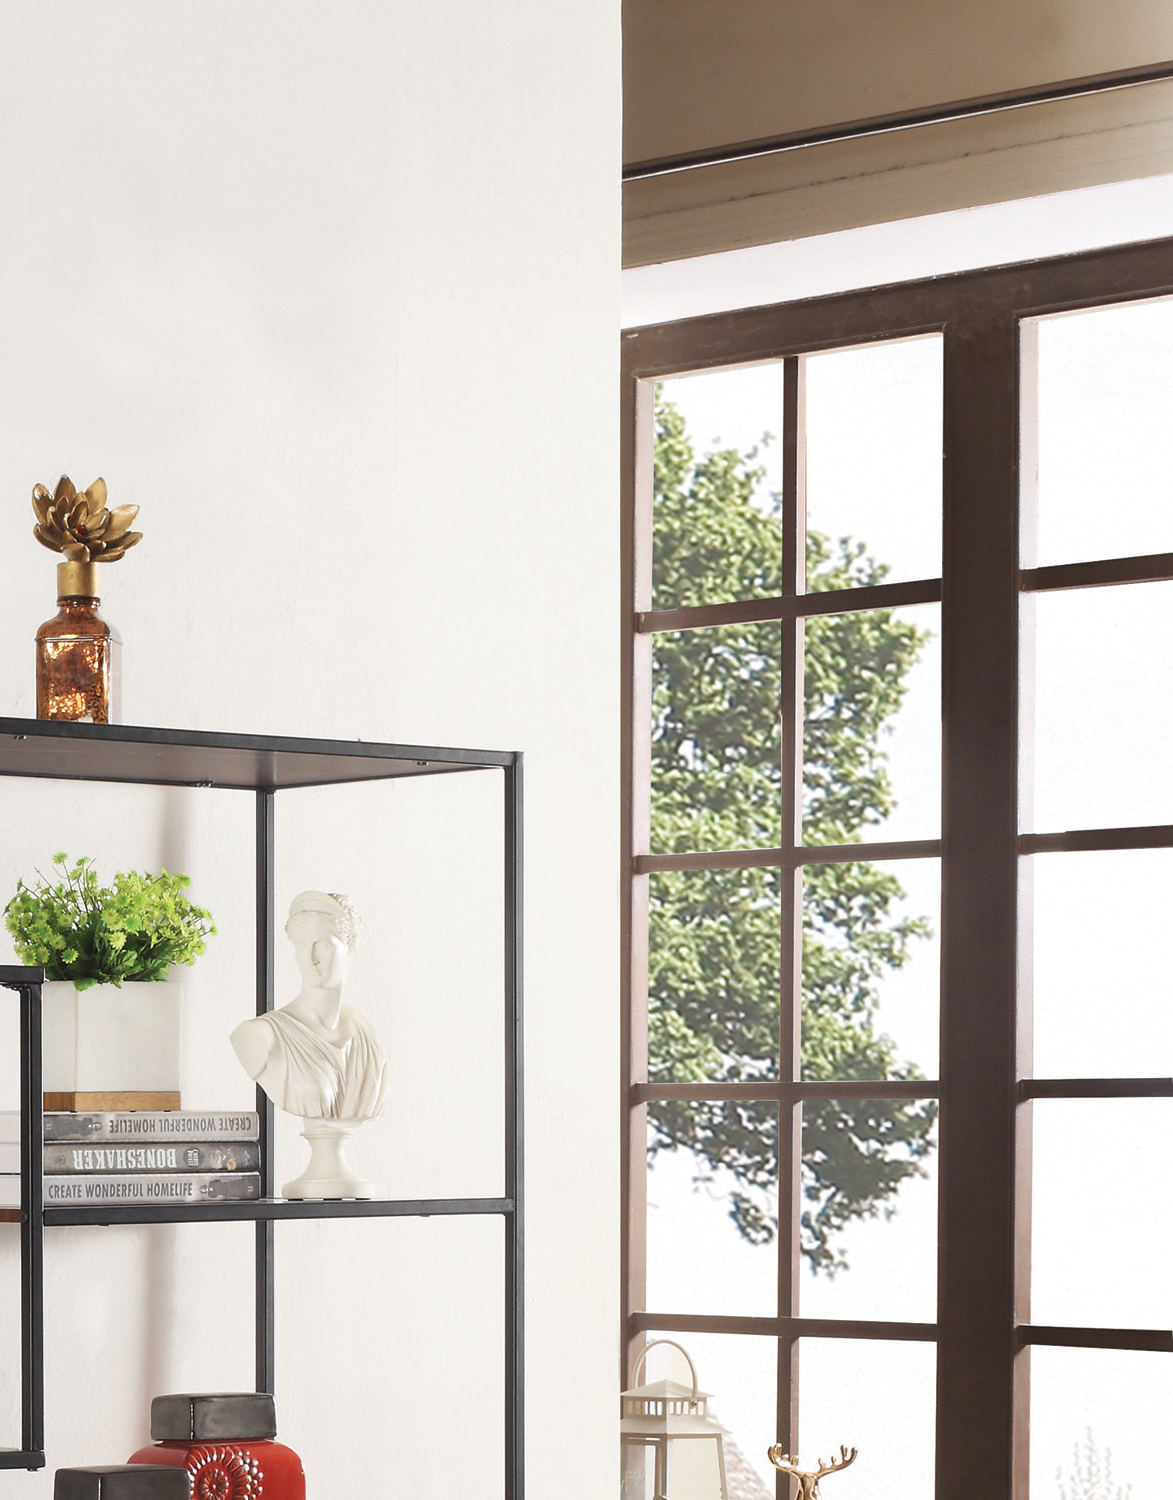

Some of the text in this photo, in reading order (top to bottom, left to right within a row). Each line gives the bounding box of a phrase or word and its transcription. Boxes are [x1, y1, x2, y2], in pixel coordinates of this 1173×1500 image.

[109, 1116, 252, 1133] CREATE WONDERFUL HOMELIFE
[72, 1148, 177, 1170] BONESHAKER
[48, 1182, 193, 1199] CREATE WONDERFUL HOMELIFE
